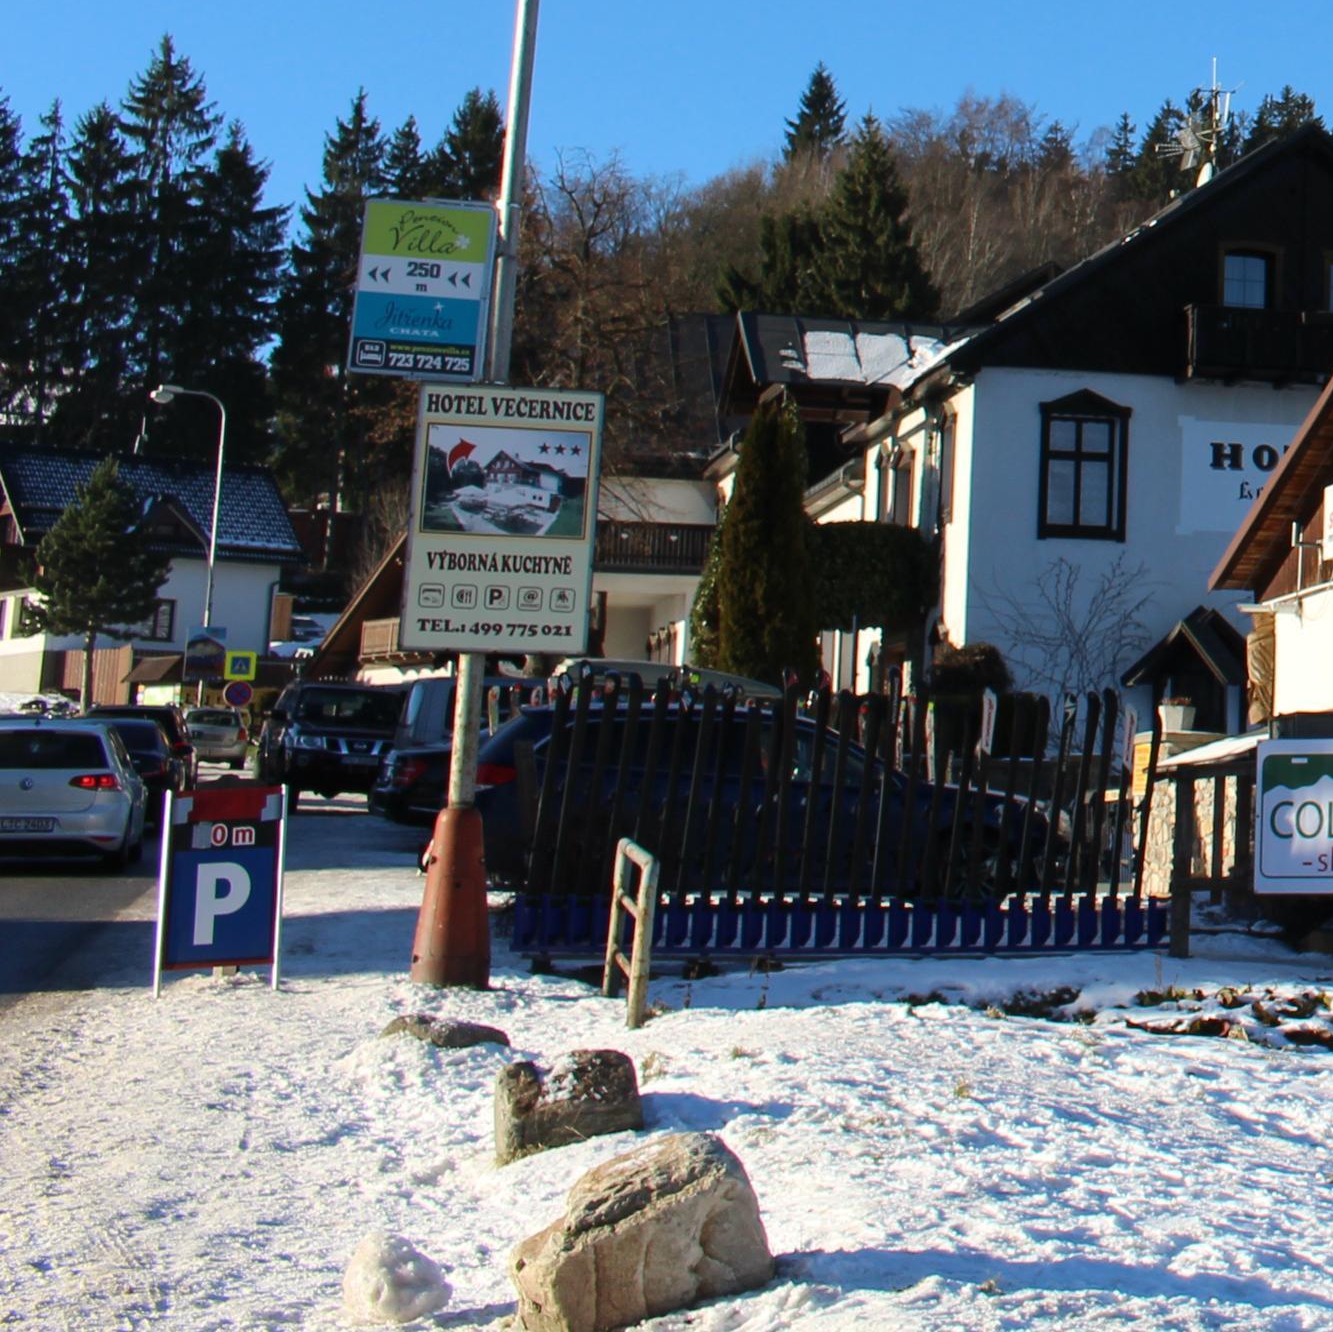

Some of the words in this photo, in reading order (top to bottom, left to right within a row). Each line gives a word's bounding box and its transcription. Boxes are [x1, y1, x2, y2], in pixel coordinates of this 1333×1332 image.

[389, 225, 460, 254] Villa
[406, 261, 442, 279] 250
[415, 283, 428, 292] m
[389, 327, 440, 337] CHATA
[389, 353, 414, 368] 723
[416, 355, 442, 370] 724
[445, 357, 470, 371] 725
[427, 393, 487, 416] HOTEL
[491, 397, 596, 422] VEČERNICE
[1209, 442, 1290, 472] HO
[427, 550, 499, 573] VÝBORNÁ
[469, 622, 503, 636] 499
[507, 624, 538, 637] 775
[542, 625, 572, 636] 021
[232, 825, 255, 845] m
[193, 861, 252, 946] P
